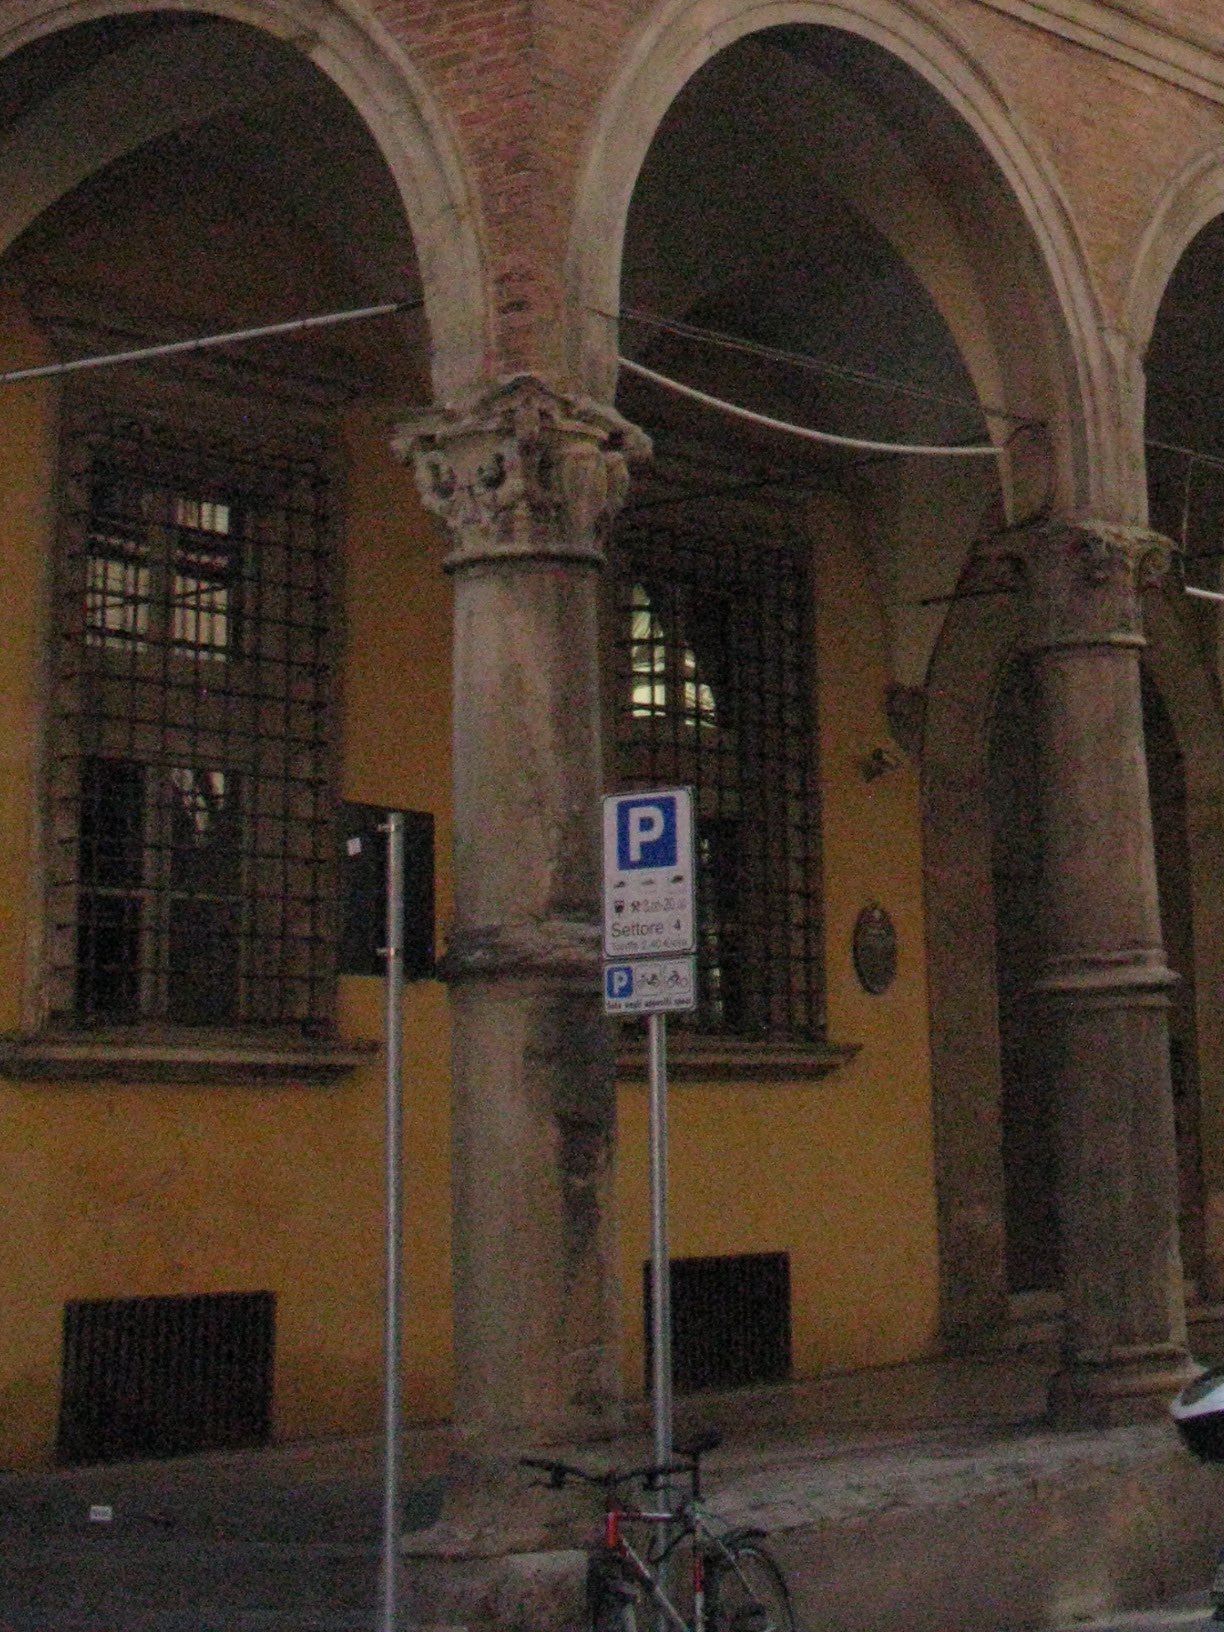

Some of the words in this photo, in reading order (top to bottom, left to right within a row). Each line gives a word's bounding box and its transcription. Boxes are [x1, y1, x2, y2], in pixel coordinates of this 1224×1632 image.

[629, 807, 664, 861] P
[611, 921, 664, 938] Settore
[613, 971, 628, 996] P
